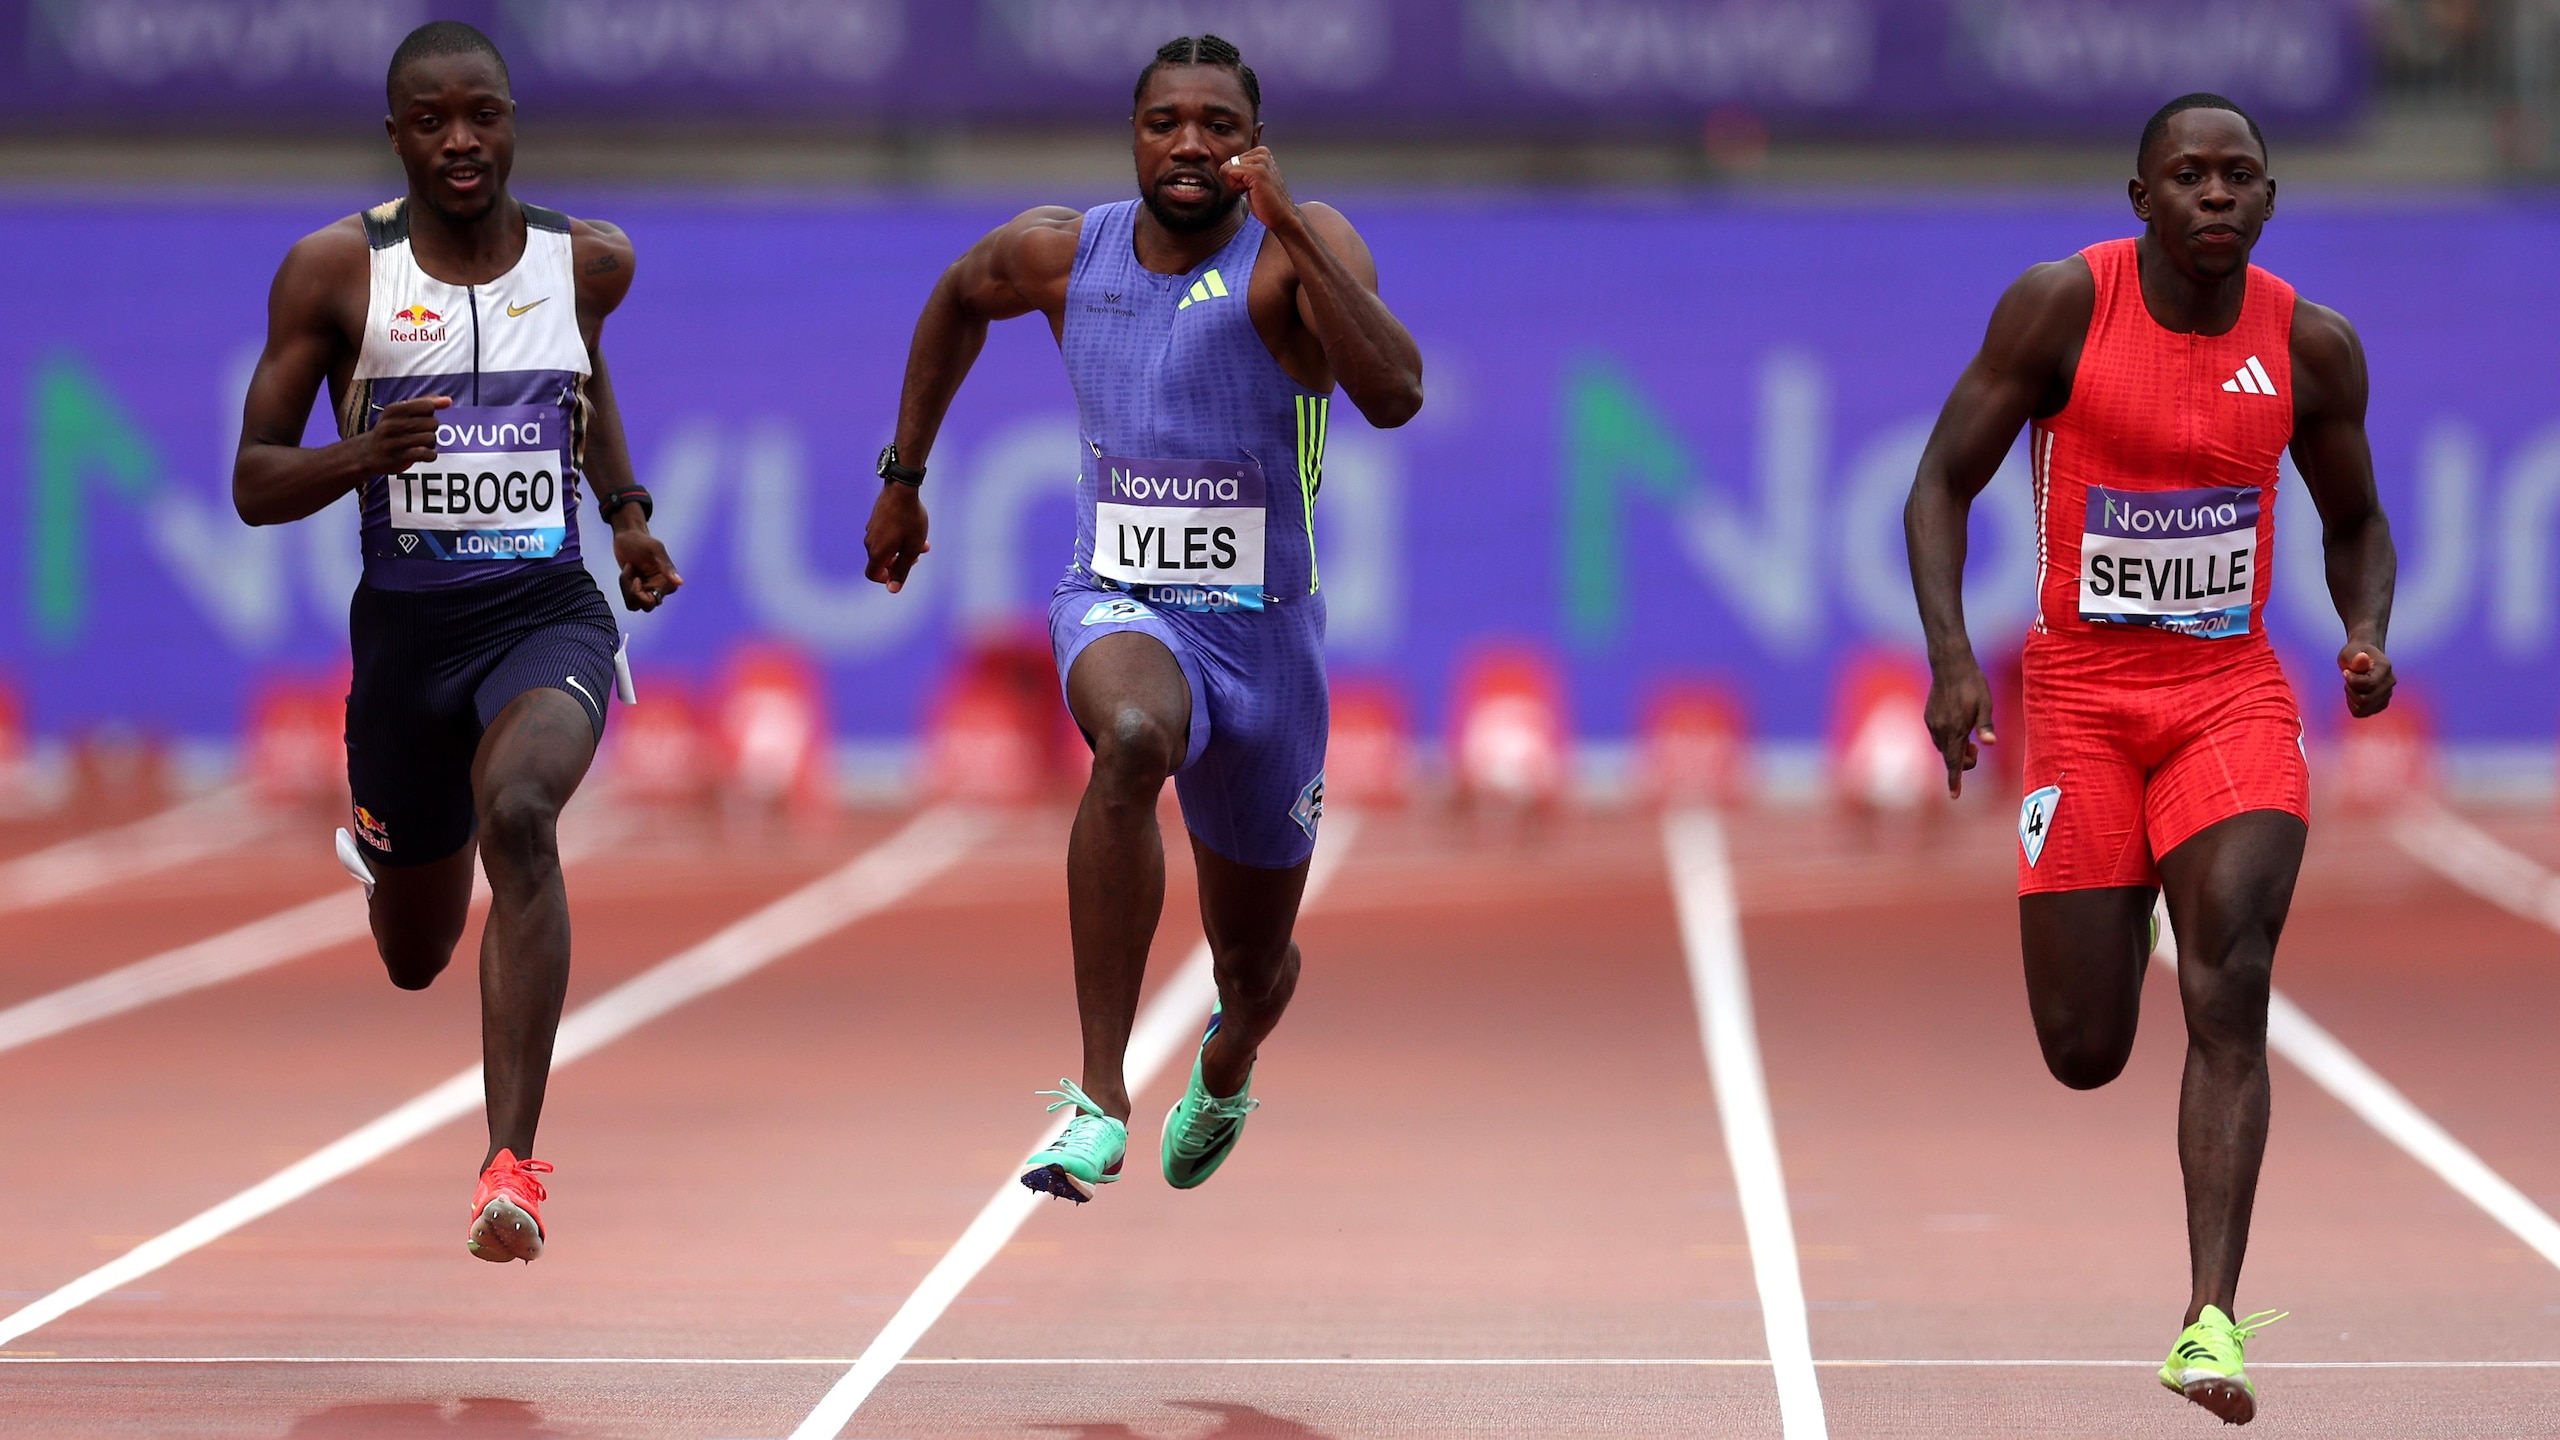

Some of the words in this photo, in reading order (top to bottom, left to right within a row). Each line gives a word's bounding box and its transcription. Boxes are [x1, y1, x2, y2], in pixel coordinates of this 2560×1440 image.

[390, 327, 417, 342] Red
[419, 327, 446, 342] Bull
[435, 422, 541, 447] ovuna
[397, 470, 554, 514] TEBOGO
[1111, 467, 1238, 501] Novuna
[2104, 499, 2237, 532] Novuna
[456, 535, 544, 554] LONDON
[1118, 524, 1237, 570] LYLES
[2089, 548, 2249, 601] SEVILLE
[1148, 587, 1238, 607] LONDON
[2028, 802, 2043, 836] 4
